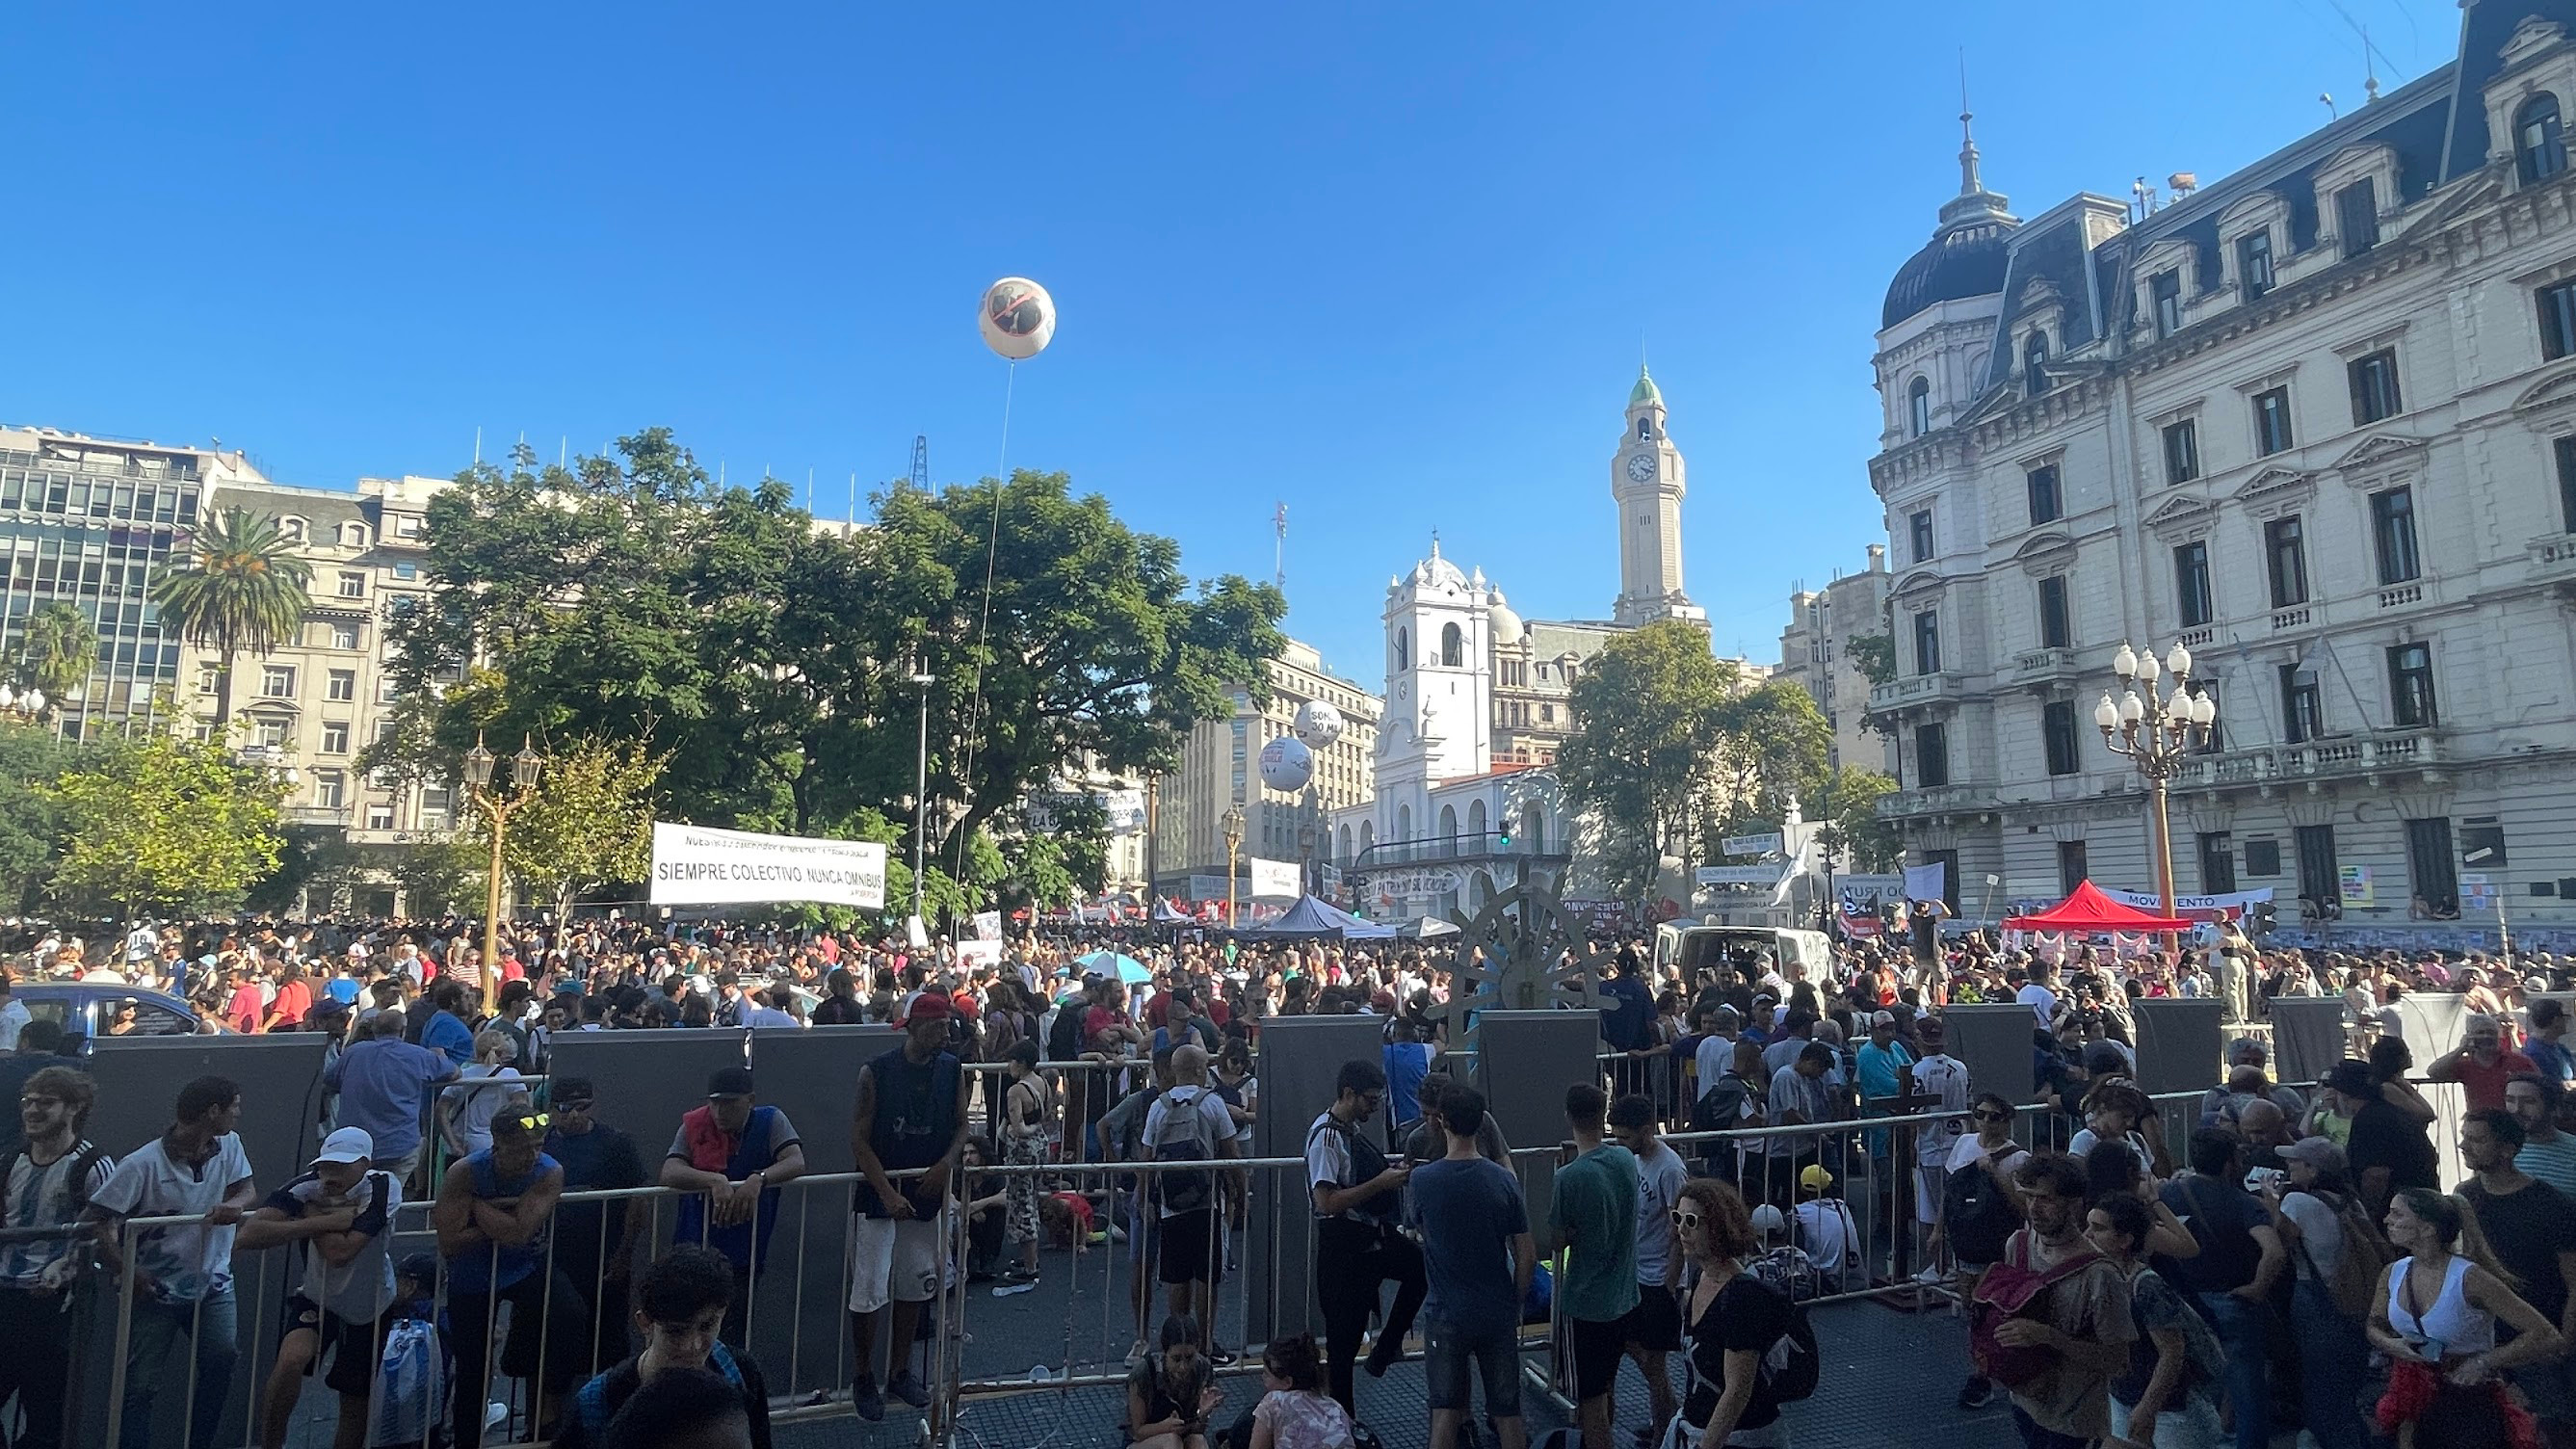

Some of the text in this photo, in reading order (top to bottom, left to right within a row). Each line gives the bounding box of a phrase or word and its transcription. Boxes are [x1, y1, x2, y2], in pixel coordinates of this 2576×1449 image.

[658, 862, 728, 881] SIEMPRE
[806, 868, 843, 884] NUNCA
[844, 870, 882, 889] OMNIBUS
[2128, 895, 2215, 908] MOVIIENTO
